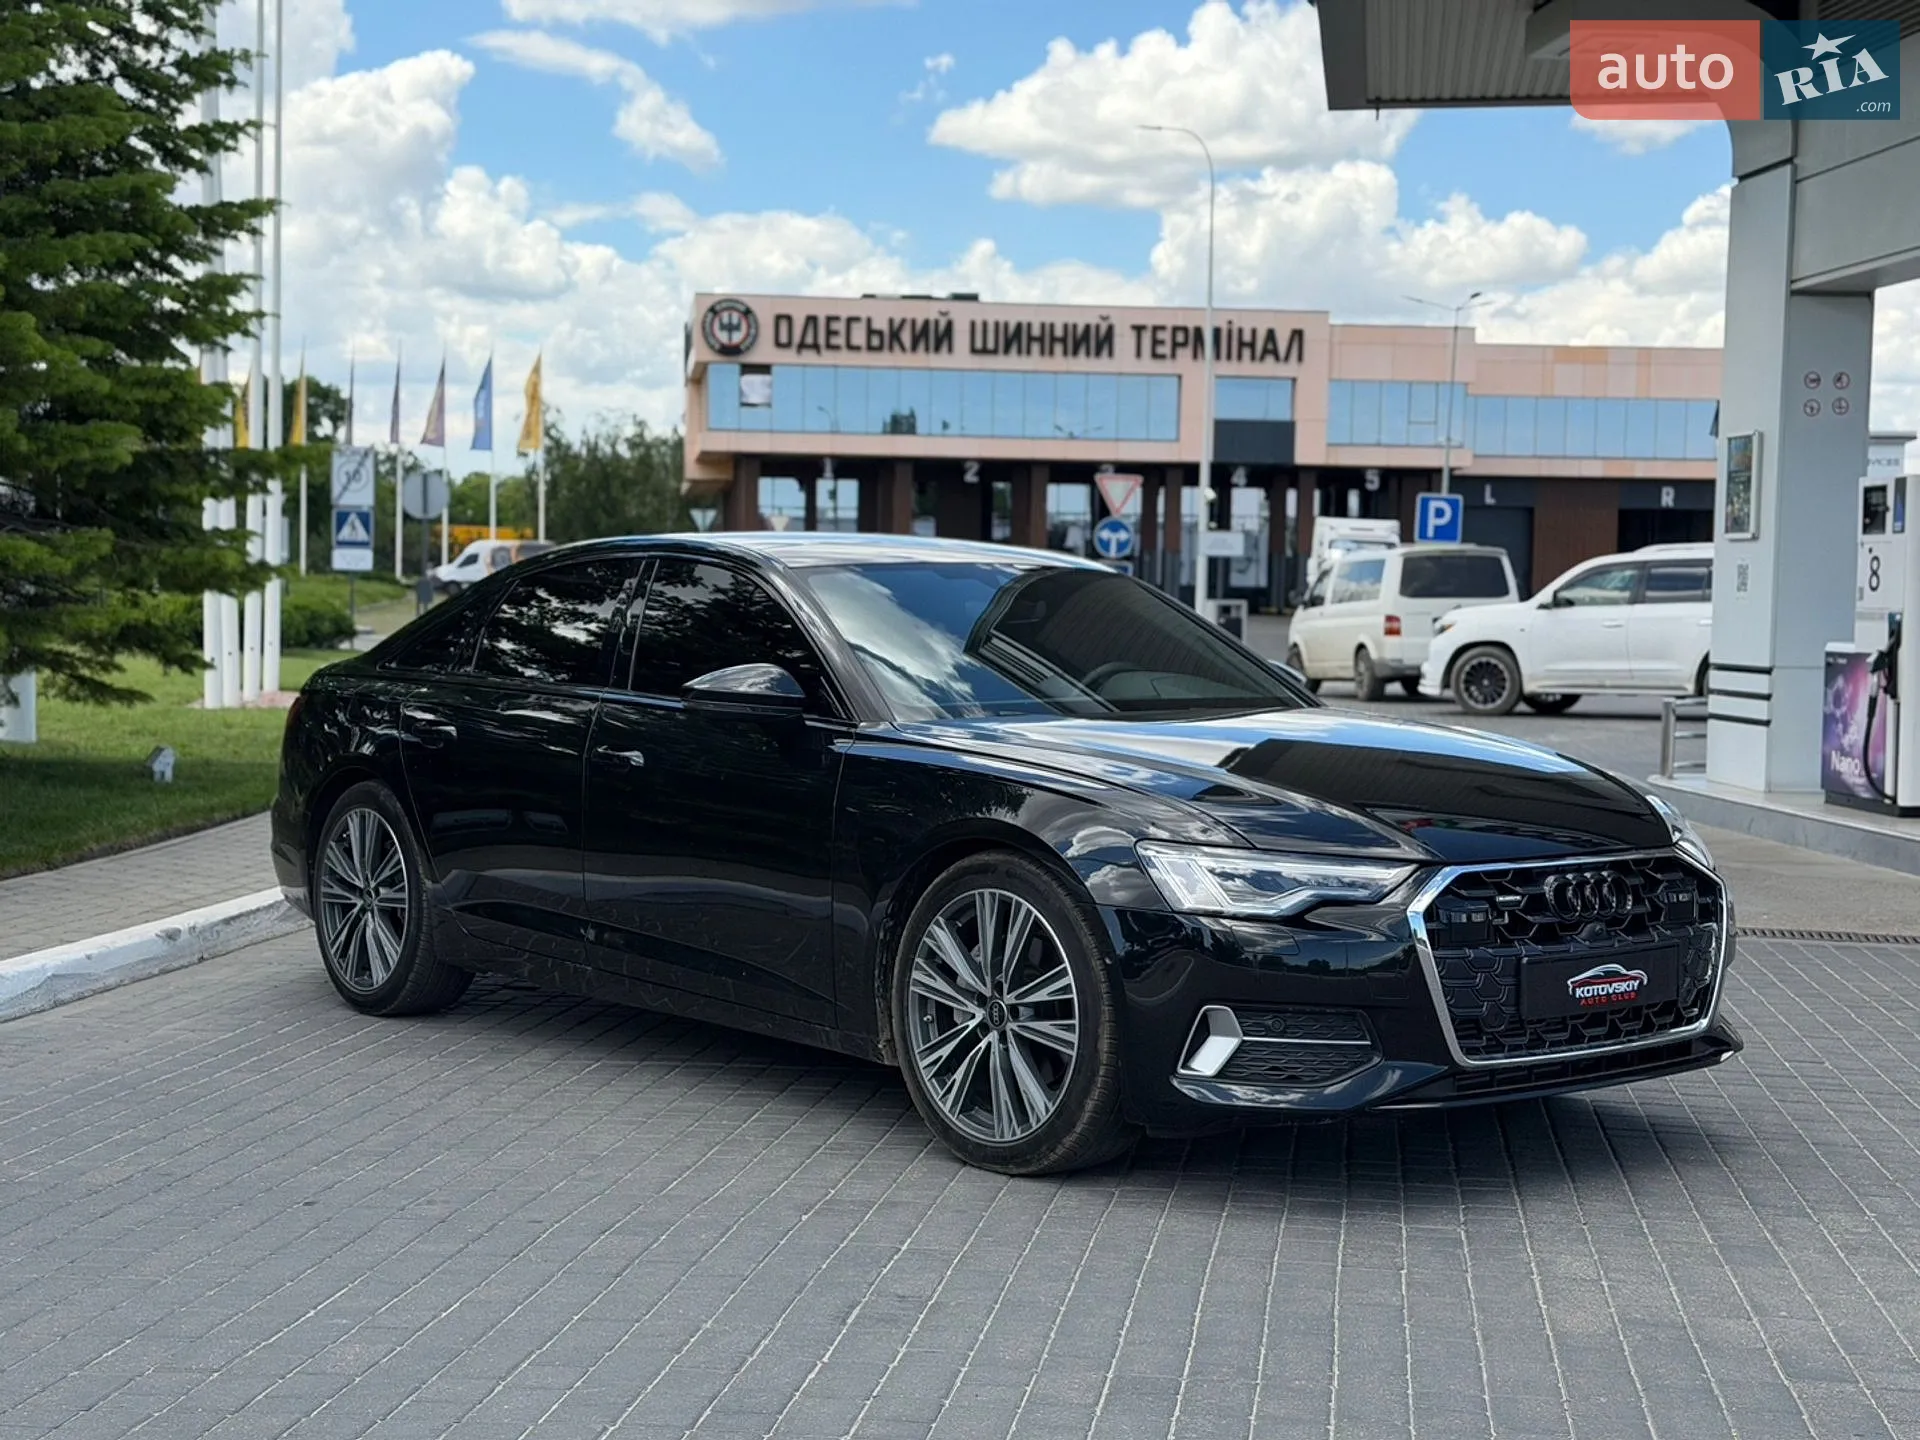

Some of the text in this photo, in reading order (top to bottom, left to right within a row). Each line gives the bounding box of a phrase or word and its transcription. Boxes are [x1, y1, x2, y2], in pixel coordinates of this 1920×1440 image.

[774, 311, 954, 355] ОДЕСЬКИЙ
[969, 315, 1115, 358] ШИННИЙ
[963, 461, 980, 483] 2
[1231, 466, 1247, 487] 4
[1484, 484, 1496, 504] L
[1661, 486, 1674, 507] R
[1426, 500, 1452, 538] P
[1869, 556, 1880, 592] 8
[1831, 750, 1862, 775] Nano
[1575, 979, 1640, 998] KOTOVSKIY
[1580, 992, 1637, 1006] AUTO CLUB
